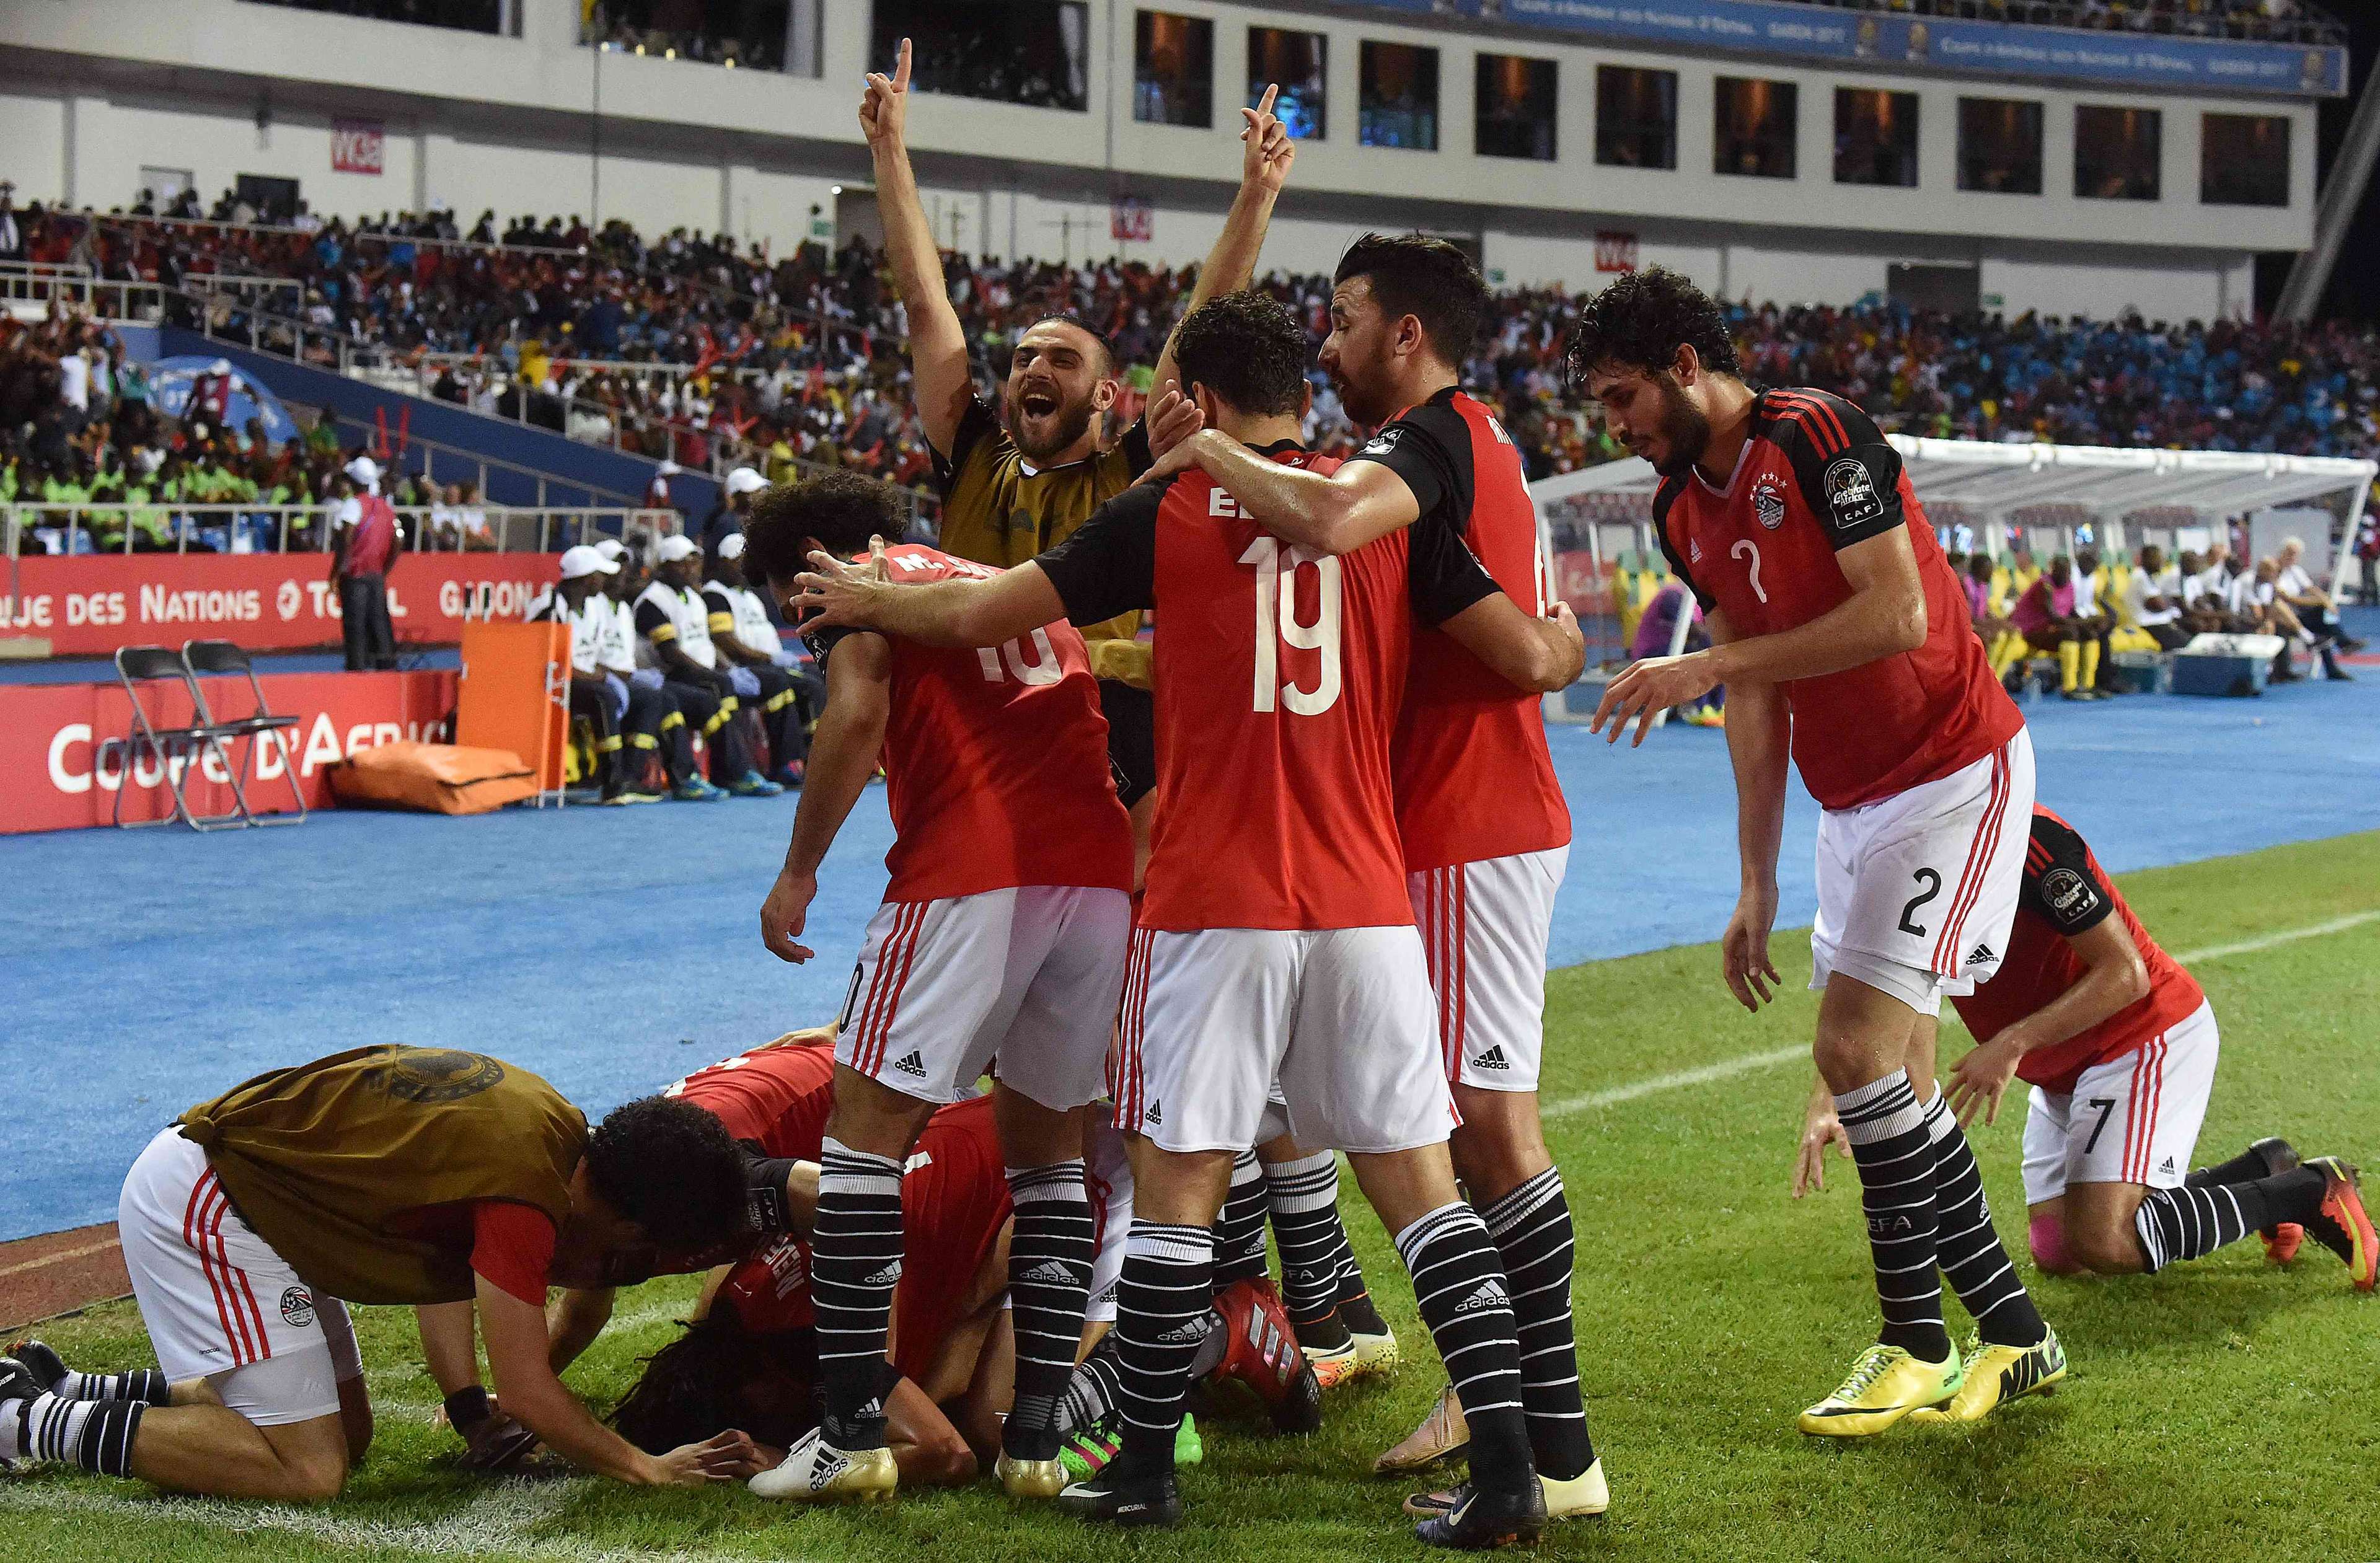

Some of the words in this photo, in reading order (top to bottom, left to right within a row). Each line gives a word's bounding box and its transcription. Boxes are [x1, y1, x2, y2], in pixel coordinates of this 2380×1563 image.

[1730, 539, 1766, 604] 2
[67, 592, 126, 626] DES
[1237, 537, 1341, 716] 19
[1898, 868, 1941, 937] 2
[1965, 955, 1999, 966] adidas
[894, 1061, 927, 1078] adidas
[1473, 1059, 1510, 1070] adidas
[2084, 1099, 2117, 1154] 7
[1019, 1271, 1080, 1285] adidas
[1455, 1295, 1511, 1313] adidas
[1996, 1332, 2065, 1404] NIKE
[810, 1458, 848, 1491] adidas
